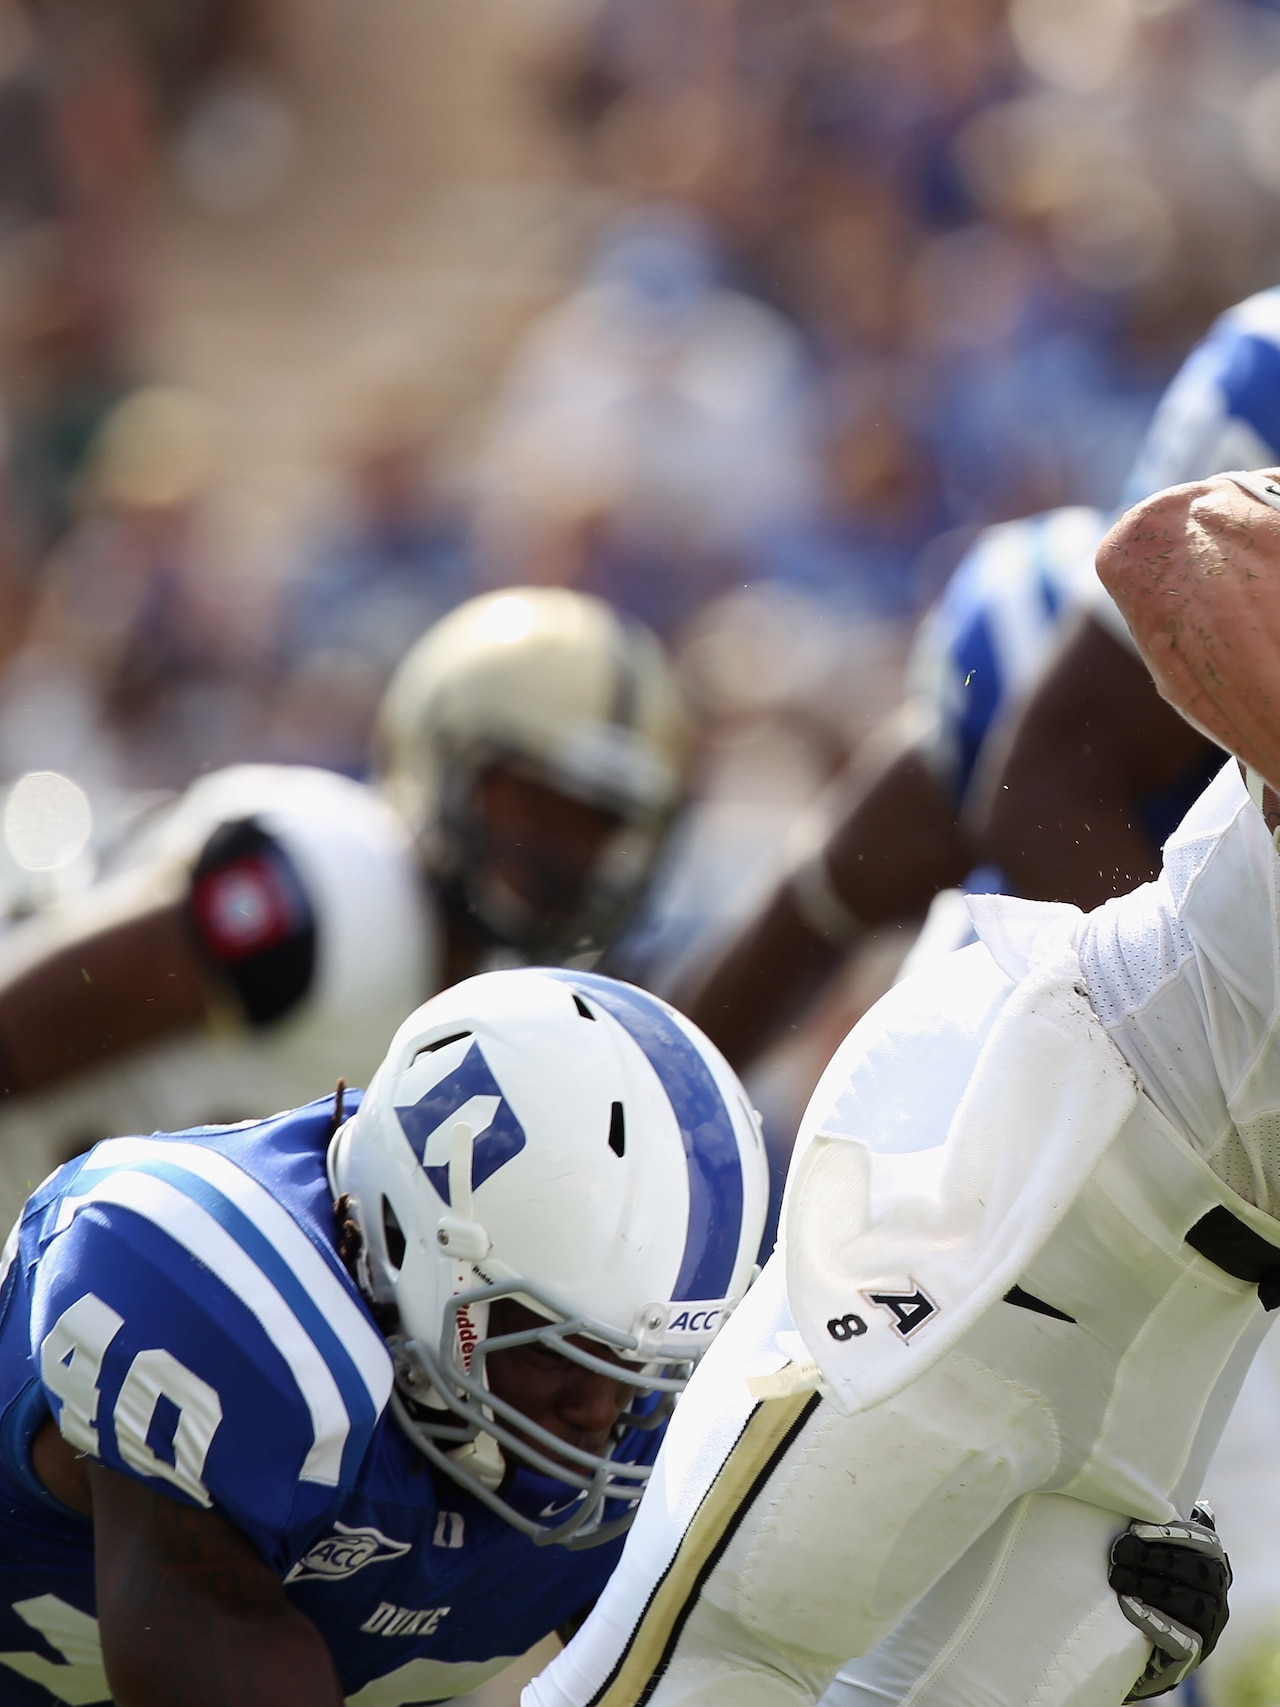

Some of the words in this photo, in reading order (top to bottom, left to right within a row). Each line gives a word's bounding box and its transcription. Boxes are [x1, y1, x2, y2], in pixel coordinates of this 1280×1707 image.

[667, 1309, 721, 1331] ACC
[858, 1276, 941, 1342] A
[827, 1313, 868, 1342] 8
[40, 1291, 224, 1510] 40
[309, 1542, 367, 1569] ACC
[359, 1601, 452, 1637] DUKE
